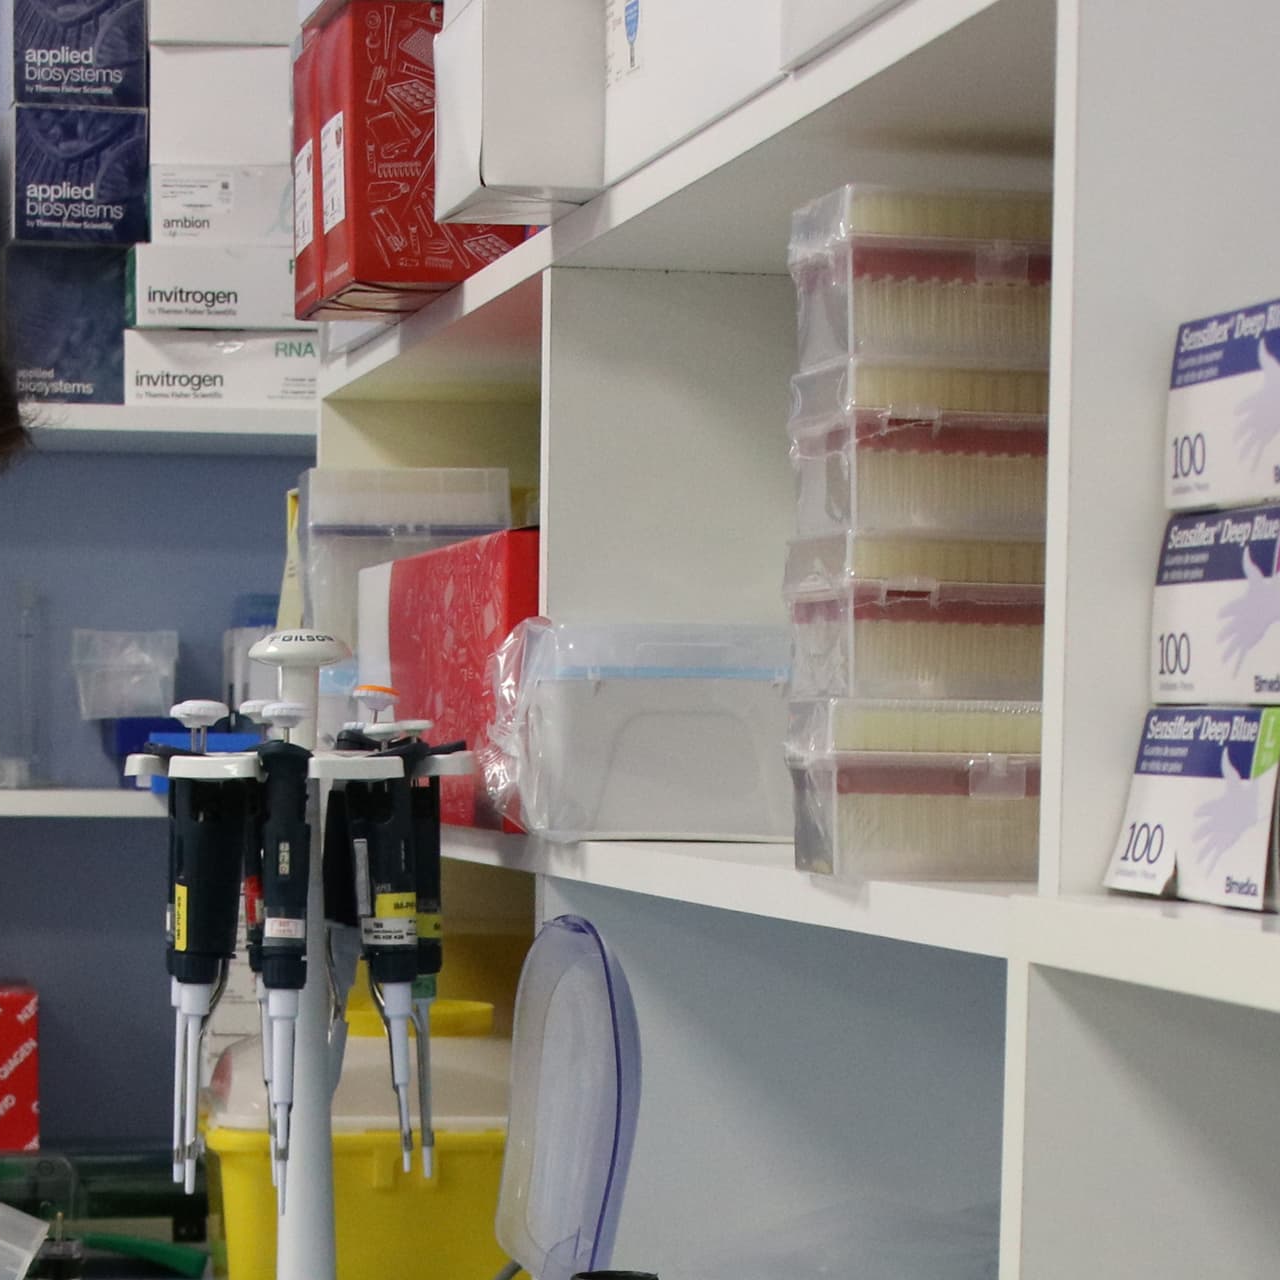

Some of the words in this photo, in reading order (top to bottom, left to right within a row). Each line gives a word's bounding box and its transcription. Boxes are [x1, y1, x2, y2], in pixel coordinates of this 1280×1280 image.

[25, 46, 94, 66] applied
[25, 63, 123, 86] biosystems
[26, 182, 95, 201] applied
[26, 200, 124, 220] biosystems
[163, 216, 210, 229] ambion
[148, 286, 238, 307] invitrogen
[274, 342, 316, 358] RNA
[135, 370, 224, 390] invitrogen
[1172, 432, 1206, 479] 100
[1220, 518, 1251, 546] Deep
[1251, 515, 1280, 541] Blue
[281, 634, 335, 642] GILSON
[1159, 633, 1191, 675] 100
[1200, 715, 1230, 746] Deep
[1230, 715, 1258, 742] Blue
[1264, 716, 1276, 748] L
[1120, 821, 1165, 865] 100
